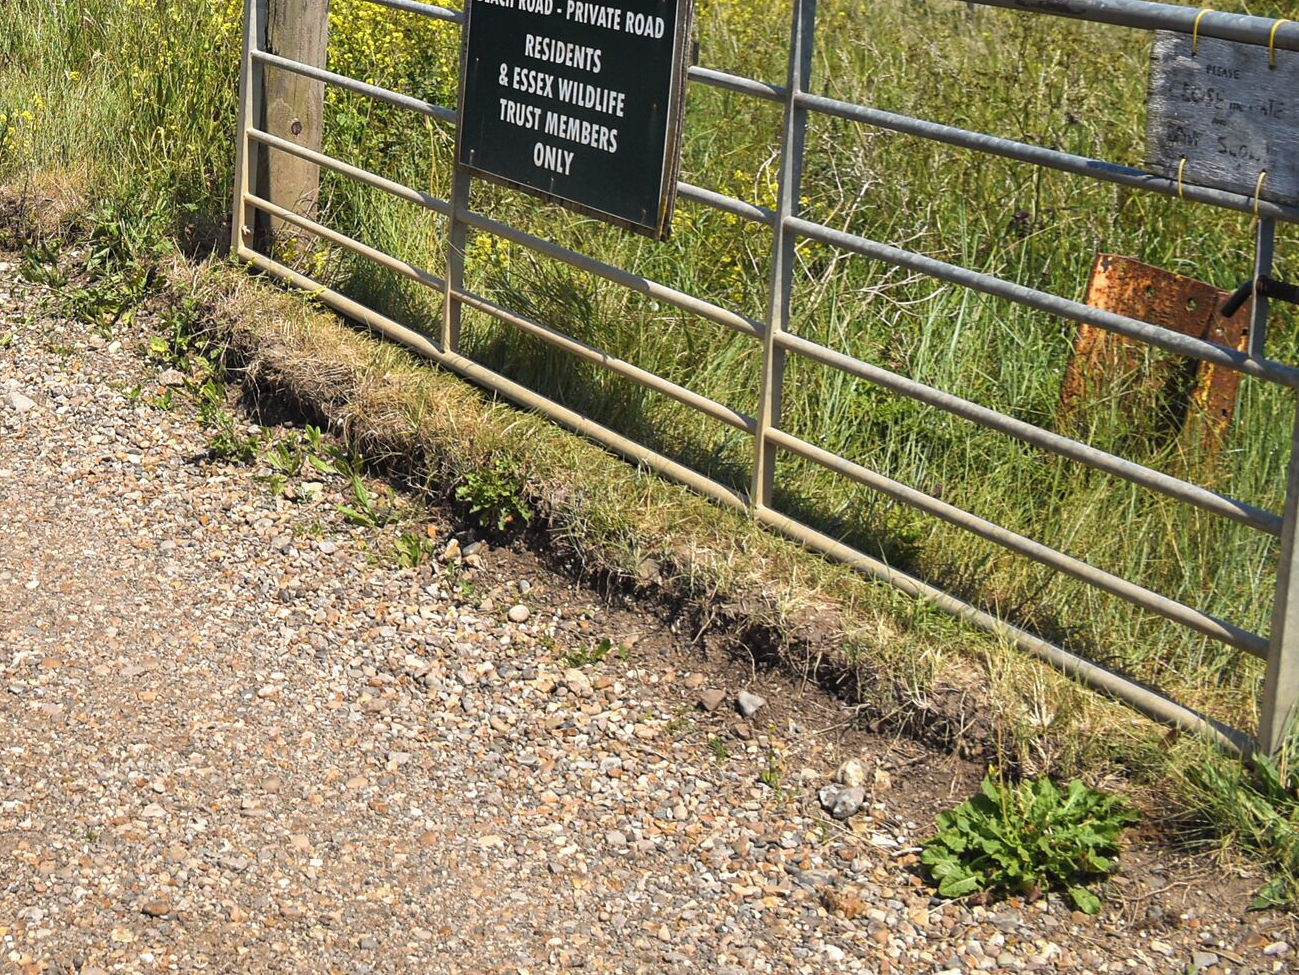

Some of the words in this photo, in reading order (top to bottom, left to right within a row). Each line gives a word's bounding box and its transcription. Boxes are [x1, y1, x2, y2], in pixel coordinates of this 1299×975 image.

[556, 6, 563, 14] -
[566, 0, 622, 31] PRIVATE
[625, 11, 665, 39] ROAD
[524, 33, 602, 74] RESIDENTS
[1205, 64, 1241, 80] PLEASE
[498, 62, 509, 87] &
[512, 66, 554, 99] ESSEX
[558, 77, 626, 118] WILDLIFE
[499, 98, 542, 131] TRUST
[544, 111, 618, 154] MEMBERS
[533, 142, 575, 176] ONLY
